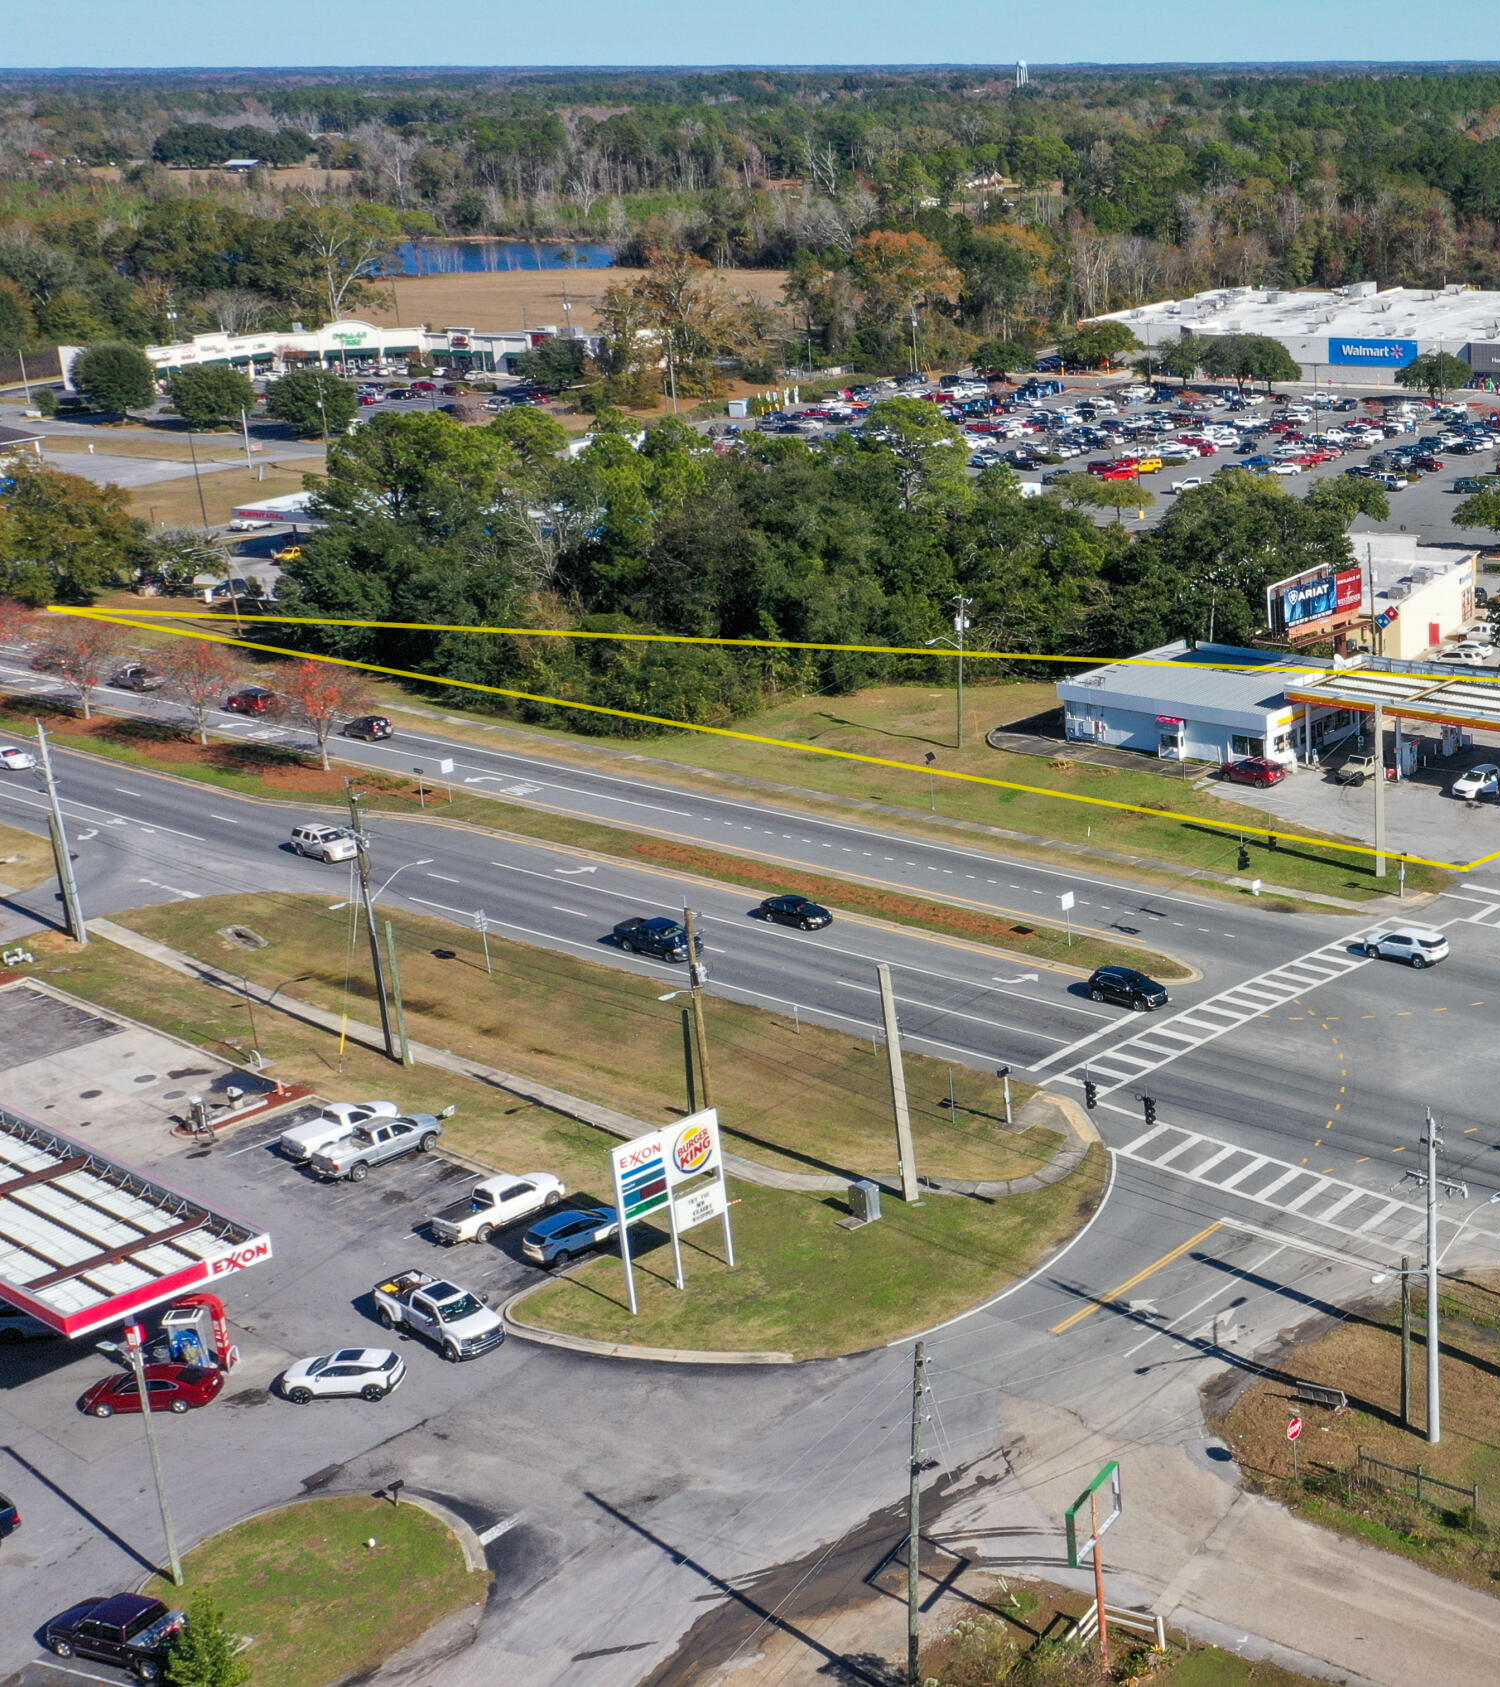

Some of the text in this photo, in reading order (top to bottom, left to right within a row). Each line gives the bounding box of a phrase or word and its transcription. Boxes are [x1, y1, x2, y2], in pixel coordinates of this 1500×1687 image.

[1341, 344, 1390, 357] Walmart
[1298, 584, 1329, 601] ARIAT
[619, 1142, 663, 1168] EXXON
[677, 1128, 709, 1157] BURGER
[680, 1136, 711, 1169] KING
[212, 1242, 268, 1275] EXXON
[1287, 1419, 1301, 1437] STOP
